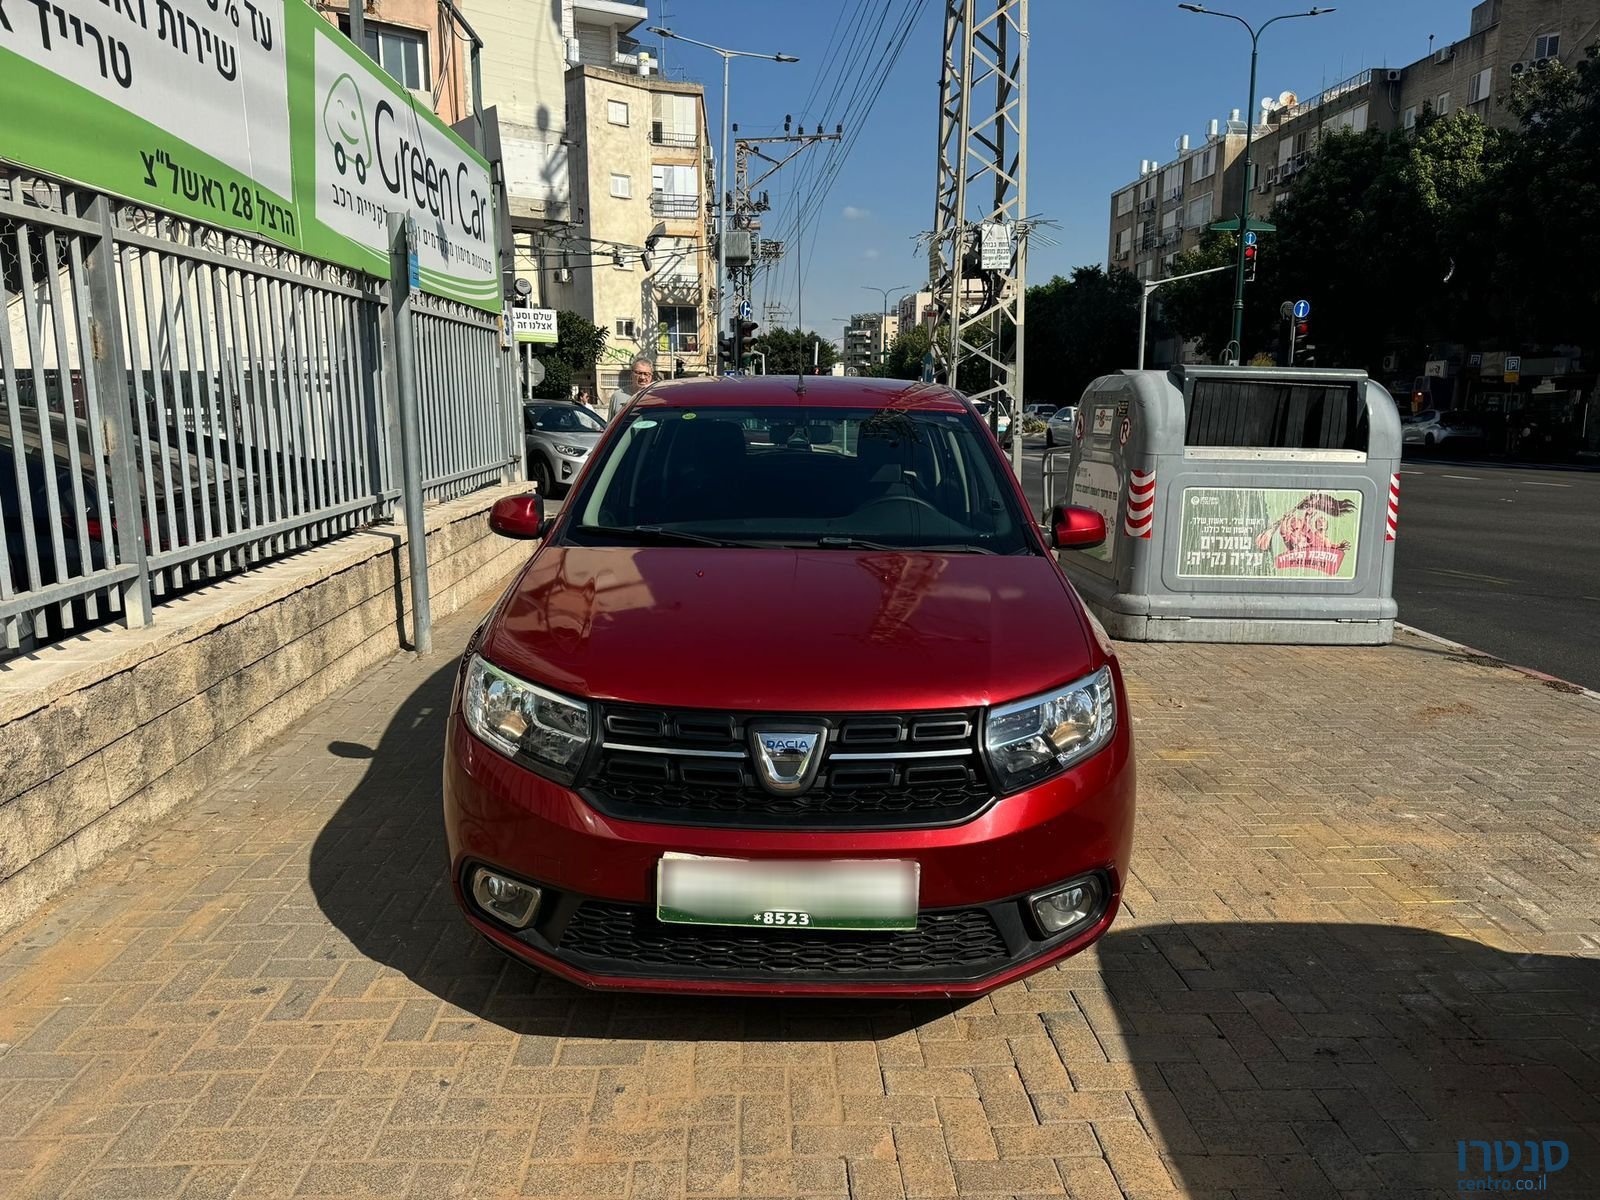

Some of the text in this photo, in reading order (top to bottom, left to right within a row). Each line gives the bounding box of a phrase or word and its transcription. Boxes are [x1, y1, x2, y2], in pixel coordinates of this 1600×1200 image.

[244, 0, 272, 51] עד
[27, 0, 132, 88] טרייד
[156, 0, 237, 81] שירות
[375, 100, 487, 243] Green Car
[139, 149, 295, 236] הרצל 28 ראשל"צ
[331, 183, 353, 214] רכב
[517, 321, 553, 330] אצלנו זה
[533, 312, 552, 320] שלם
[1220, 525, 1232, 533] של
[1233, 526, 1253, 534] ראשון
[1187, 550, 1263, 568] עליה נקייה!
[766, 740, 809, 749] DACIA
